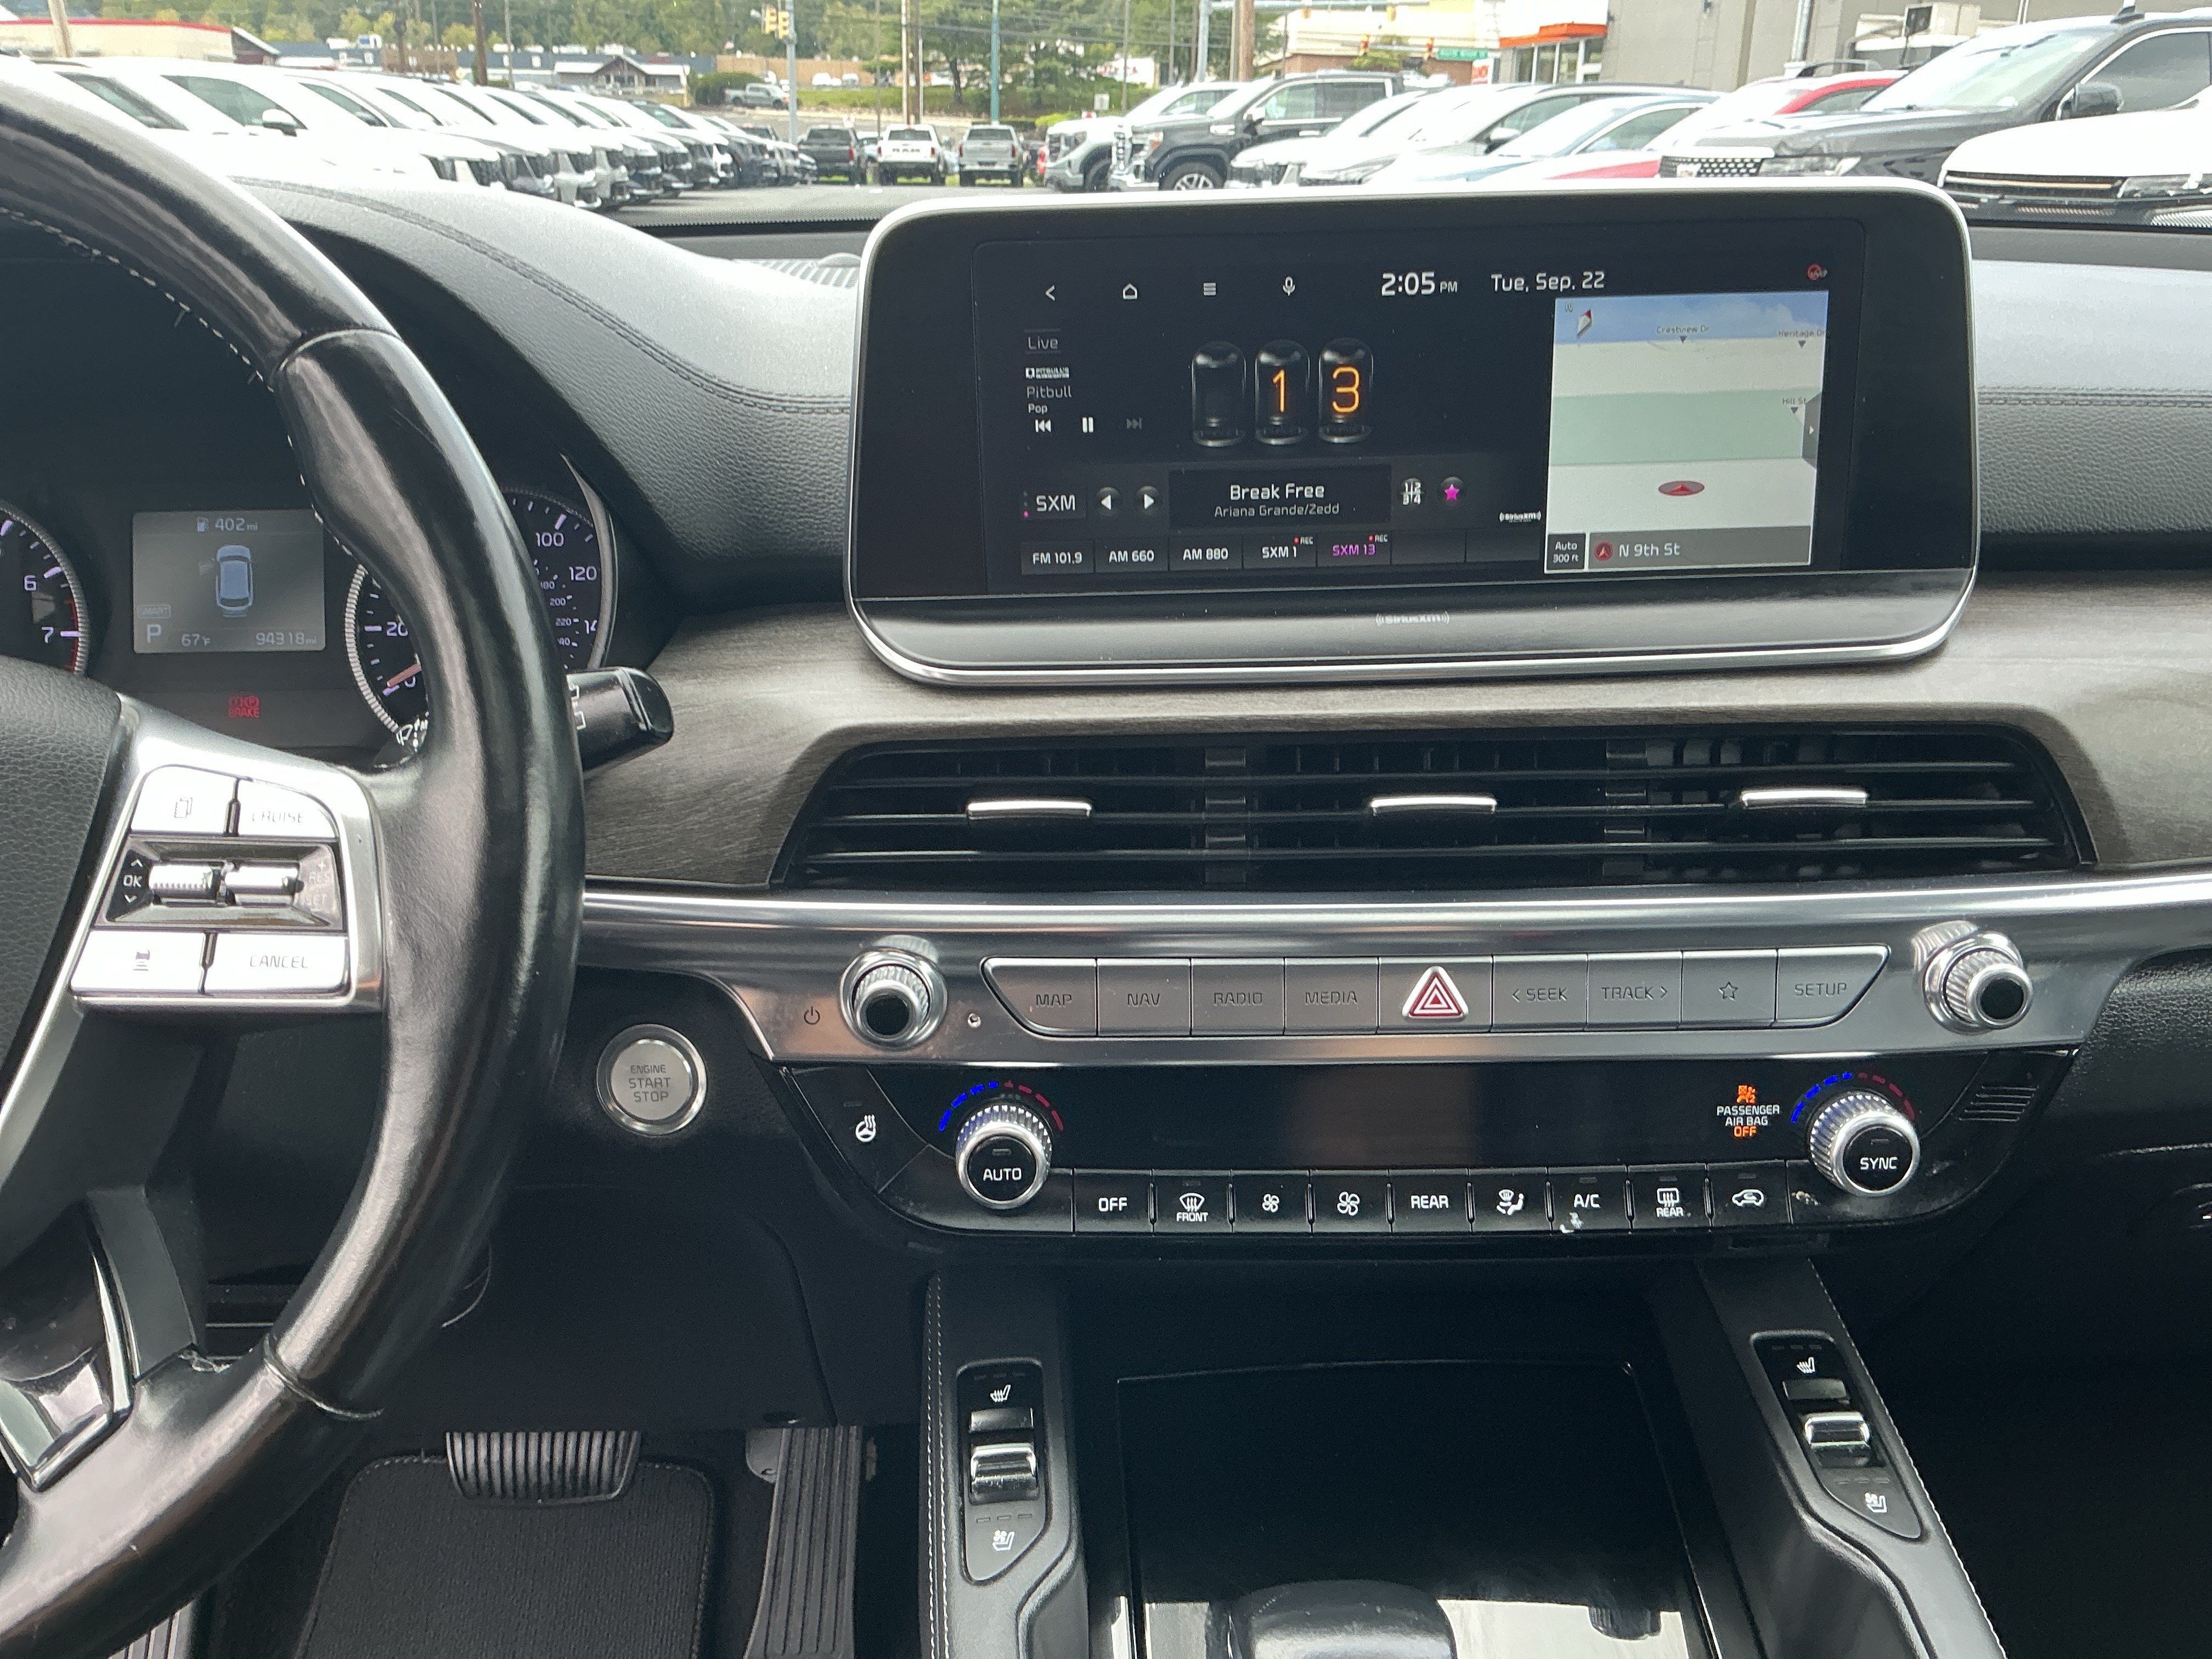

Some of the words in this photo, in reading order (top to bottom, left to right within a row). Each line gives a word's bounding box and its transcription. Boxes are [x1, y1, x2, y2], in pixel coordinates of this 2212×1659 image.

[1381, 272, 1435, 296] 2:05
[1440, 281, 1458, 293] PM
[1491, 274, 1529, 292] Tue,
[1536, 273, 1575, 292] Sep.
[1582, 271, 1605, 289] 22
[1028, 336, 1058, 349] Live
[1027, 385, 1072, 399] Pitbull
[1028, 403, 1048, 415] Pop
[1230, 484, 1280, 500] Break
[1285, 483, 1324, 499] Free
[1036, 495, 1075, 512] SXM
[1215, 506, 1255, 517] Ariana
[1259, 503, 1340, 516] Grande/Zedd
[535, 532, 565, 547] 100
[1555, 541, 1577, 551] Auto
[1109, 550, 1128, 563] AM
[1132, 550, 1154, 562] 660
[1183, 549, 1202, 561] AM
[1206, 548, 1228, 560] 880
[1262, 546, 1289, 559] SXM
[1293, 546, 1297, 557] 1
[1333, 545, 1359, 556] SXM
[1363, 544, 1376, 555] 13
[1619, 544, 1629, 557] N
[1634, 544, 1659, 557] 9th
[1664, 543, 1680, 556] St
[1032, 552, 1051, 565] FM
[1054, 551, 1082, 565] 101.9
[1572, 554, 1579, 563] ft
[569, 566, 597, 581] 120
[24, 575, 37, 591] 6
[550, 597, 566, 606] 200
[556, 618, 572, 627] 220
[42, 627, 54, 643] 7
[147, 624, 162, 644] P
[123, 874, 142, 889] OK
[250, 955, 308, 969] CANCEL
[1526, 987, 1567, 1002] SEEK
[1601, 985, 1654, 1000] TRACK
[1794, 982, 1847, 998] SETUP
[1035, 994, 1073, 1008] MAP
[1127, 992, 1161, 1007] NAV
[1213, 992, 1263, 1007] RADIO
[1305, 991, 1358, 1006] MEDIA
[631, 1064, 666, 1074] ENGINE
[629, 1077, 670, 1088] START
[634, 1091, 669, 1102] STOP
[1717, 1105, 1780, 1116] PASSENGER
[1725, 1117, 1743, 1126] AIR
[1746, 1116, 1768, 1126] BAG
[1734, 1126, 1757, 1137] OFF
[1860, 1156, 1898, 1170] SYNC
[983, 1167, 1022, 1181] AUTO
[1098, 1197, 1127, 1212] OFF
[1410, 1195, 1449, 1209] REAR
[1573, 1194, 1600, 1208] A/C
[1176, 1211, 1209, 1222] FRONT
[1656, 1207, 1684, 1217] REAR
